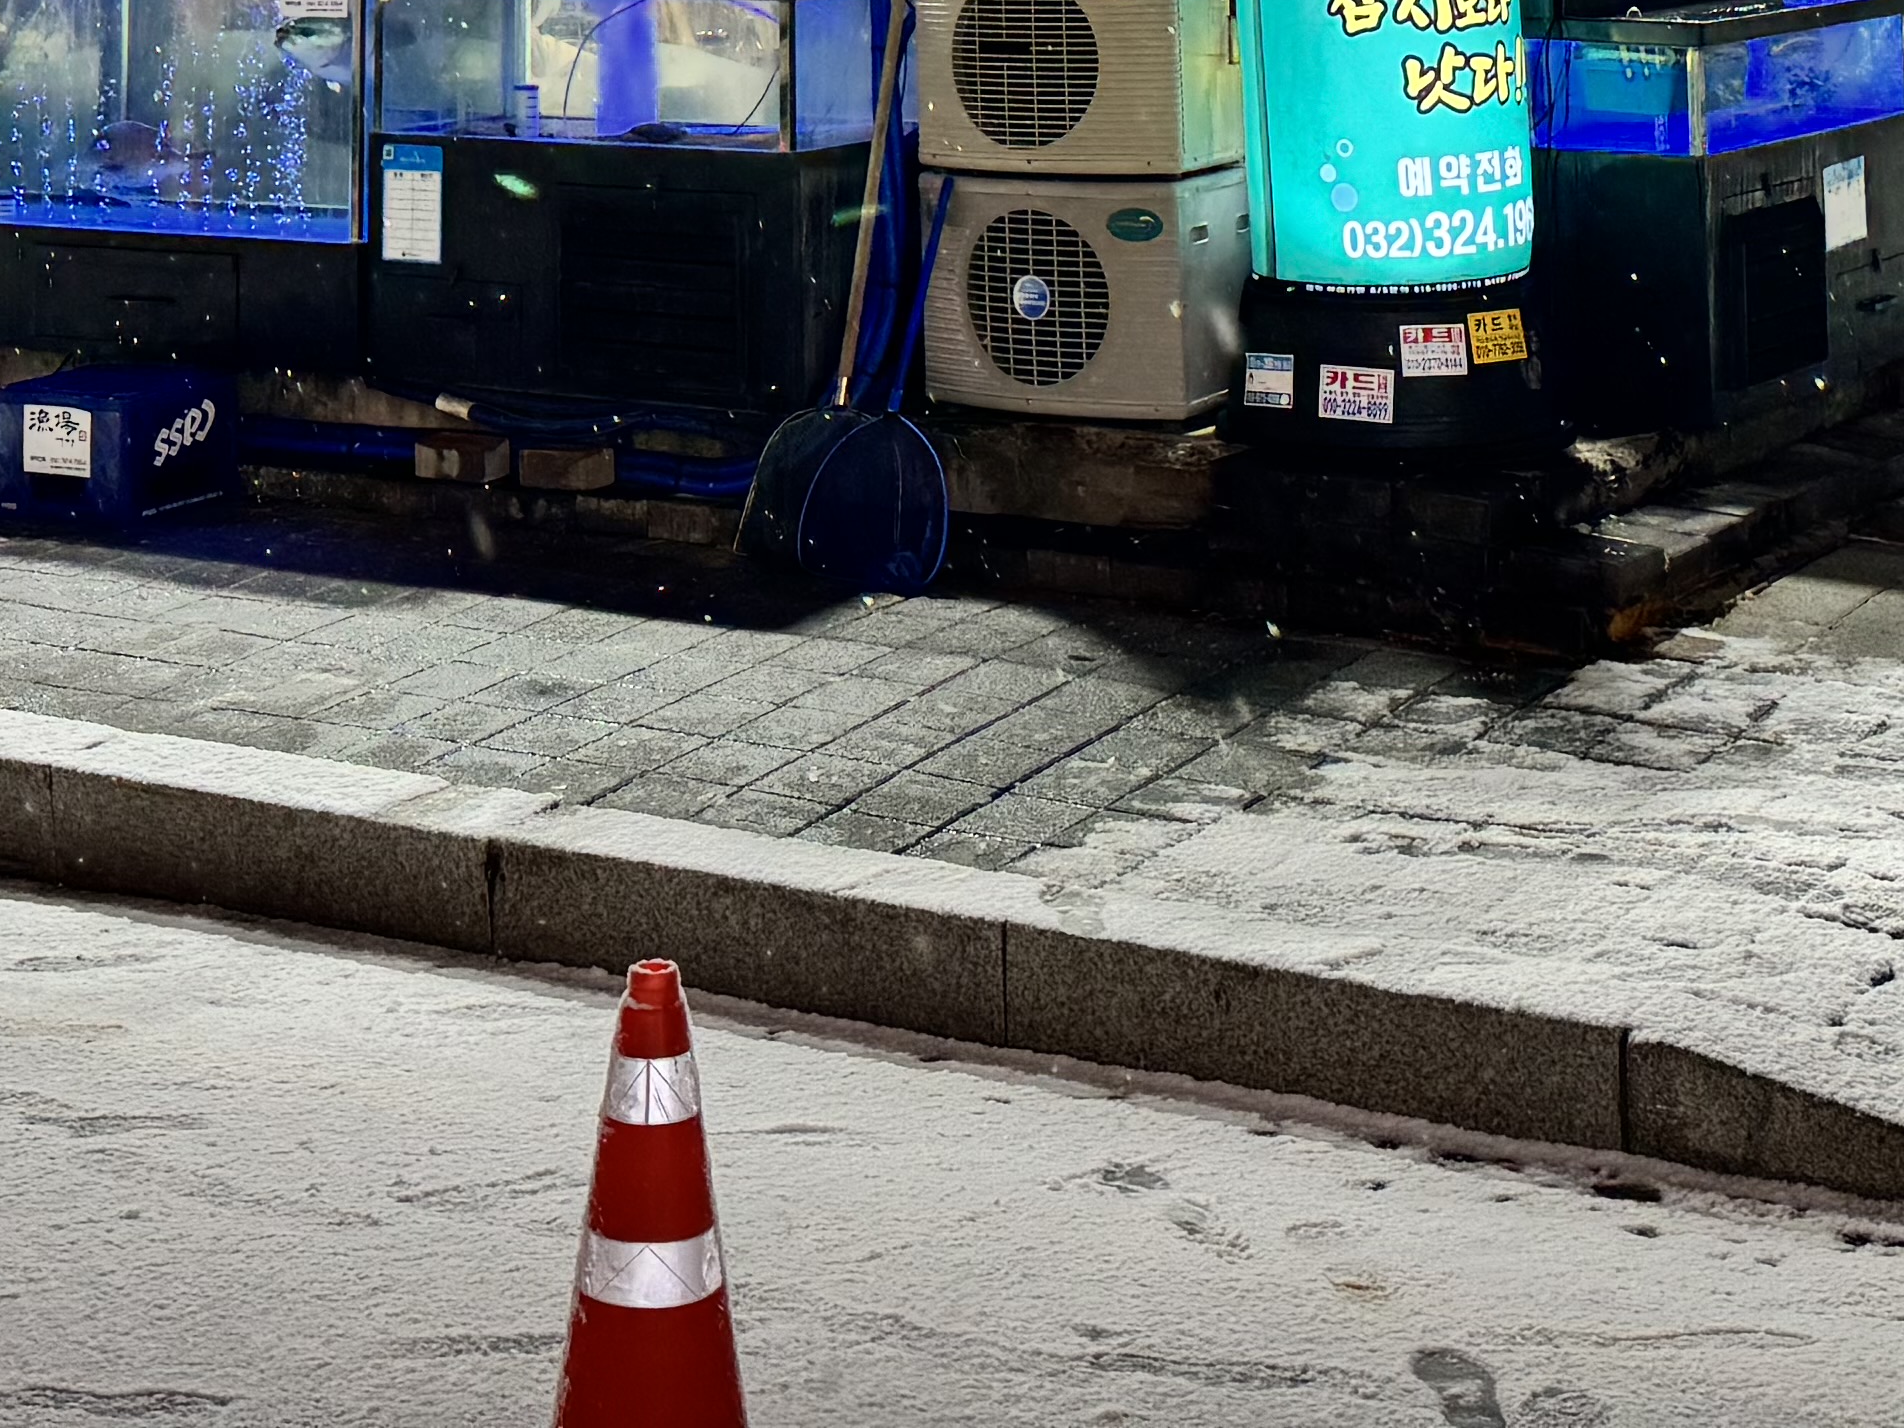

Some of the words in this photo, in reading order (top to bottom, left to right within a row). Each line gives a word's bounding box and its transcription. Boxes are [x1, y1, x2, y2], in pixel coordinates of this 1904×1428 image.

[1397, 145, 1523, 197] 예약전화
[1325, 369, 1375, 392] 카드
[154, 398, 216, 467] Cass
